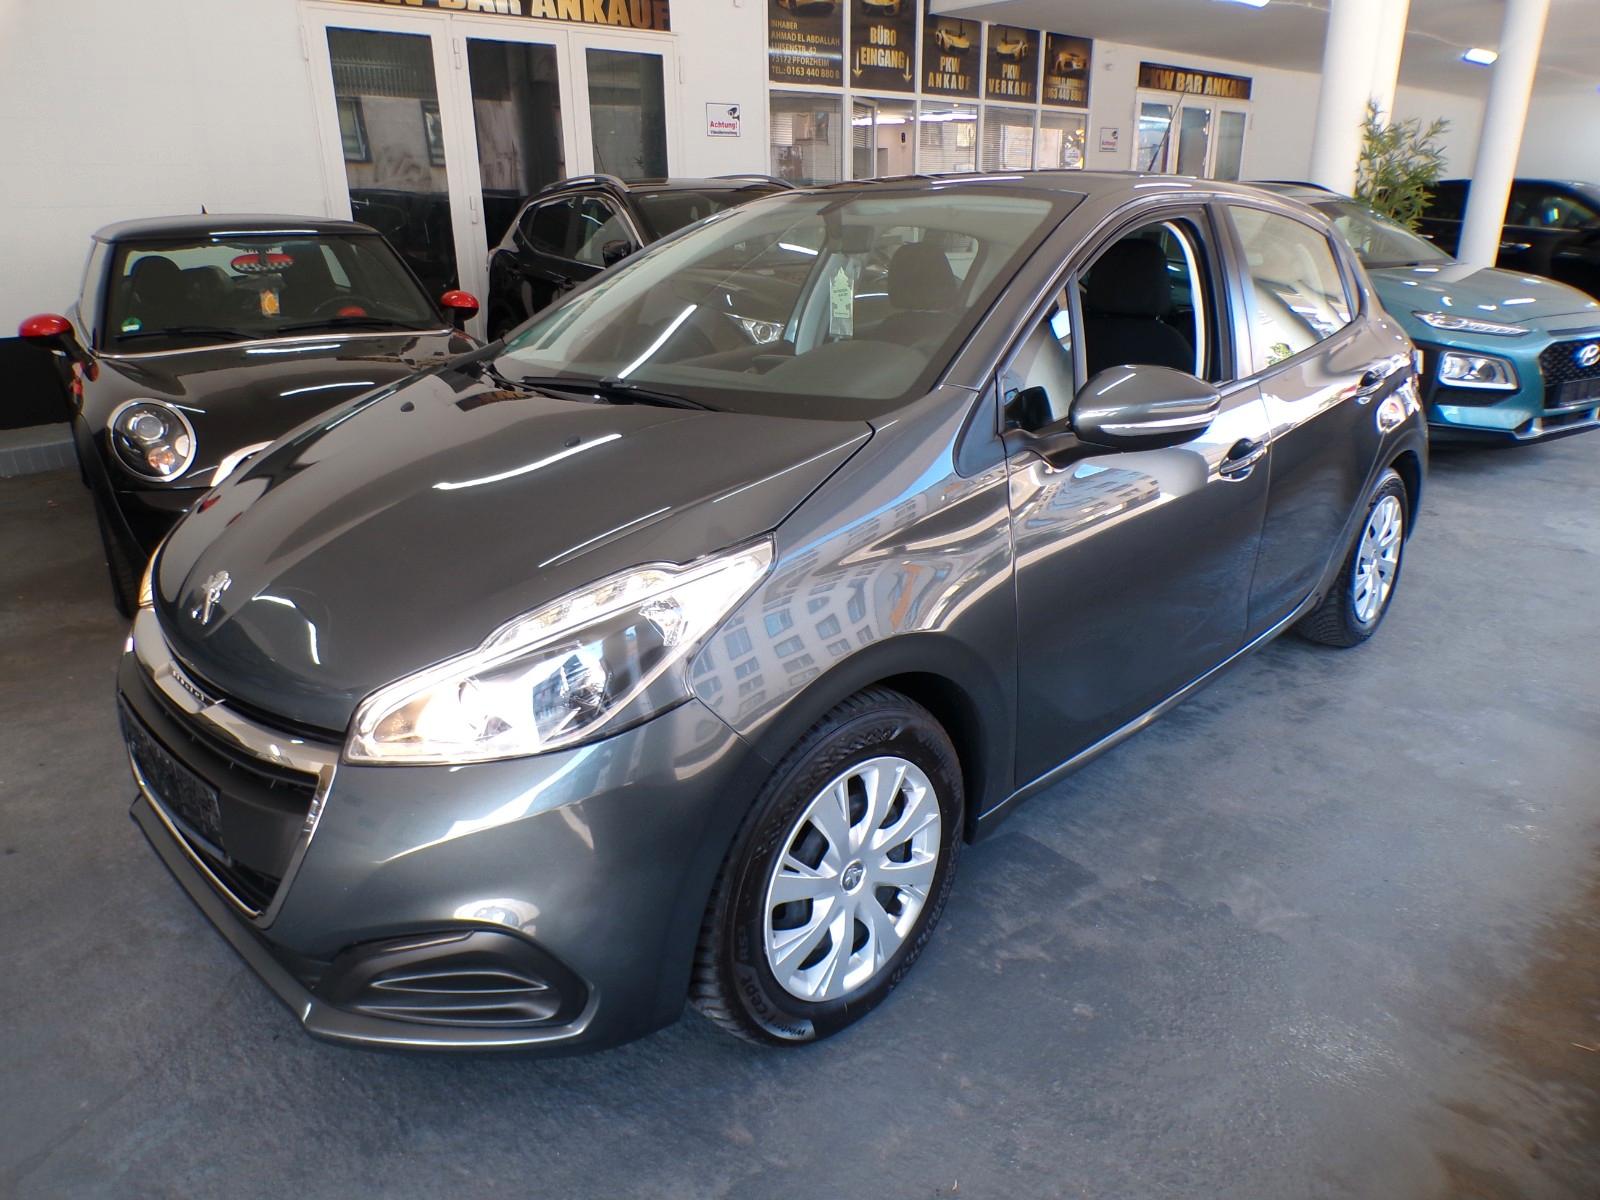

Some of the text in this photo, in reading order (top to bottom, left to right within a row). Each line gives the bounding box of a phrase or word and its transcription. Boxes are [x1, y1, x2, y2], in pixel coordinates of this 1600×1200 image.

[770, 31, 840, 46] AHMAD EL ABDALLAH
[870, 25, 897, 45] BÜRO
[792, 56, 830, 66] PFORZHEIM
[860, 47, 905, 69] EINGANG
[939, 56, 960, 73] PKW
[786, 66, 804, 76] 0163
[806, 68, 820, 77] 440
[1002, 64, 1021, 79] PKW
[927, 72, 970, 90] ANKAUF
[988, 79, 1032, 96] VERKAUF
[1175, 72, 1203, 94] BAR
[710, 120, 738, 130] Achtung!
